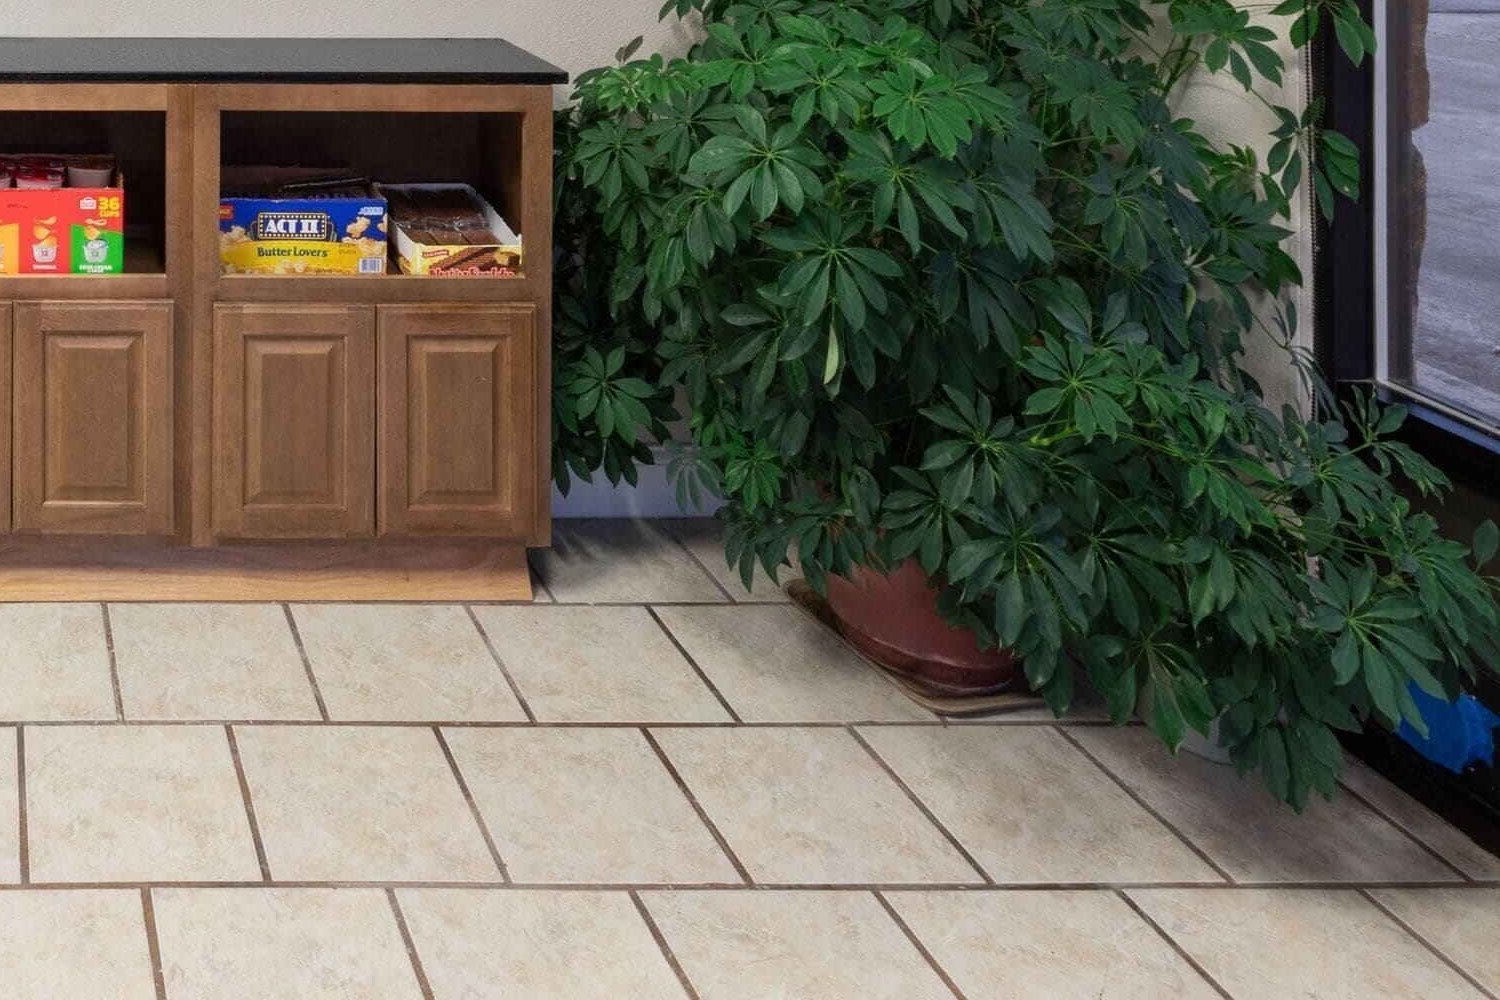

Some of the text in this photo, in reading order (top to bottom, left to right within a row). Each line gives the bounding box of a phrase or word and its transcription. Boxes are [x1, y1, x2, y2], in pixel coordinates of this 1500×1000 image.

[98, 197, 120, 211] 36
[99, 210, 120, 218] CUPS
[265, 219, 320, 234] ACT II
[41, 249, 49, 257] 12
[257, 248, 290, 258] Butter
